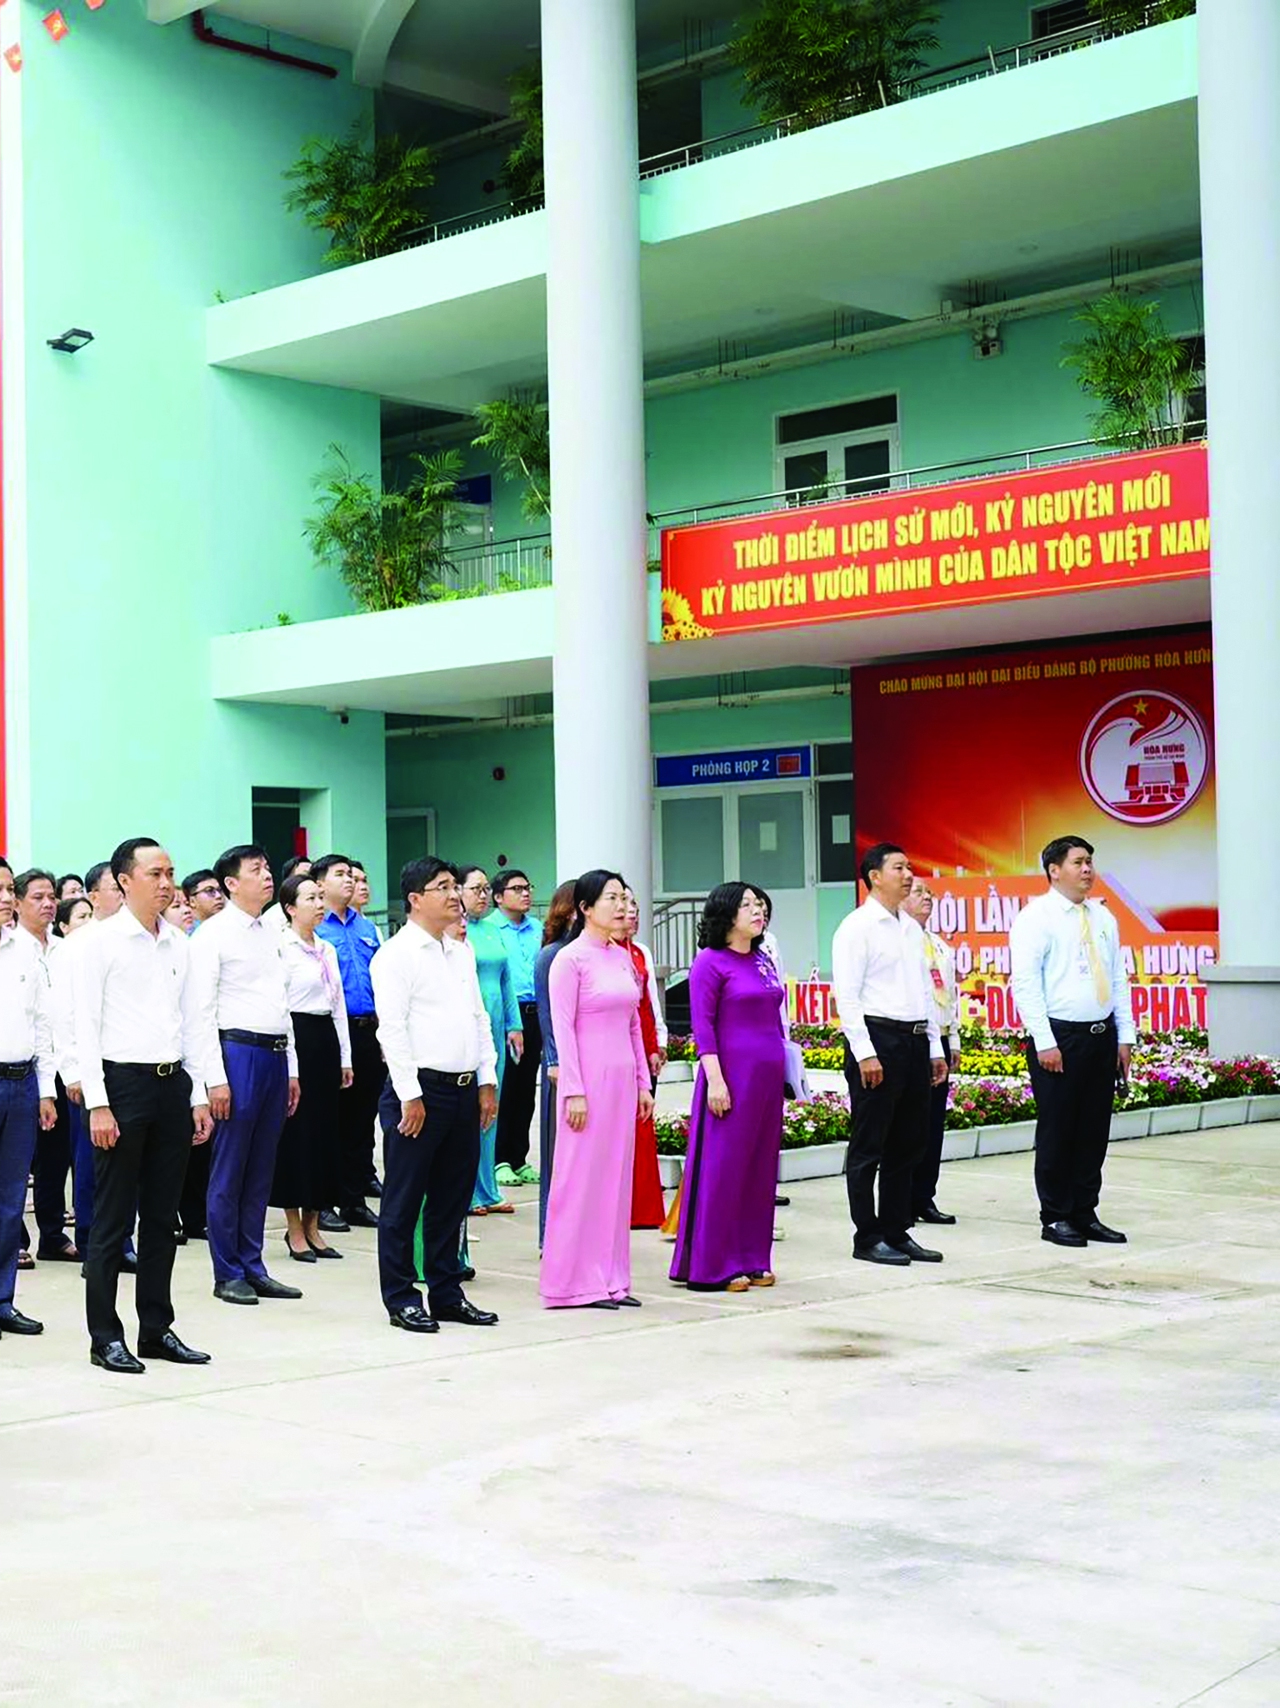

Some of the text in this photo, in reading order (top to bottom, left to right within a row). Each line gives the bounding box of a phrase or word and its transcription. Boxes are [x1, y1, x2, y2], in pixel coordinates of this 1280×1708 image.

[733, 469, 1170, 570] THỜI ĐIỂM LỊCH SỬ MỚI, KỶ NGUYÊN MỚI
[700, 517, 1210, 616] KỶ NGUYÊN VƯƠN MÌNH CỦA DÂN TỘC VIỆT NAM
[946, 671, 966, 689] ĐẠI
[968, 667, 988, 686] HỘI
[991, 667, 1011, 685] ĐẠI
[1080, 656, 1097, 677] BỘ
[1184, 647, 1213, 665] HƯN
[692, 758, 770, 777] PHÒNG HỌP 2
[1130, 977, 1209, 1033] PHÁT
